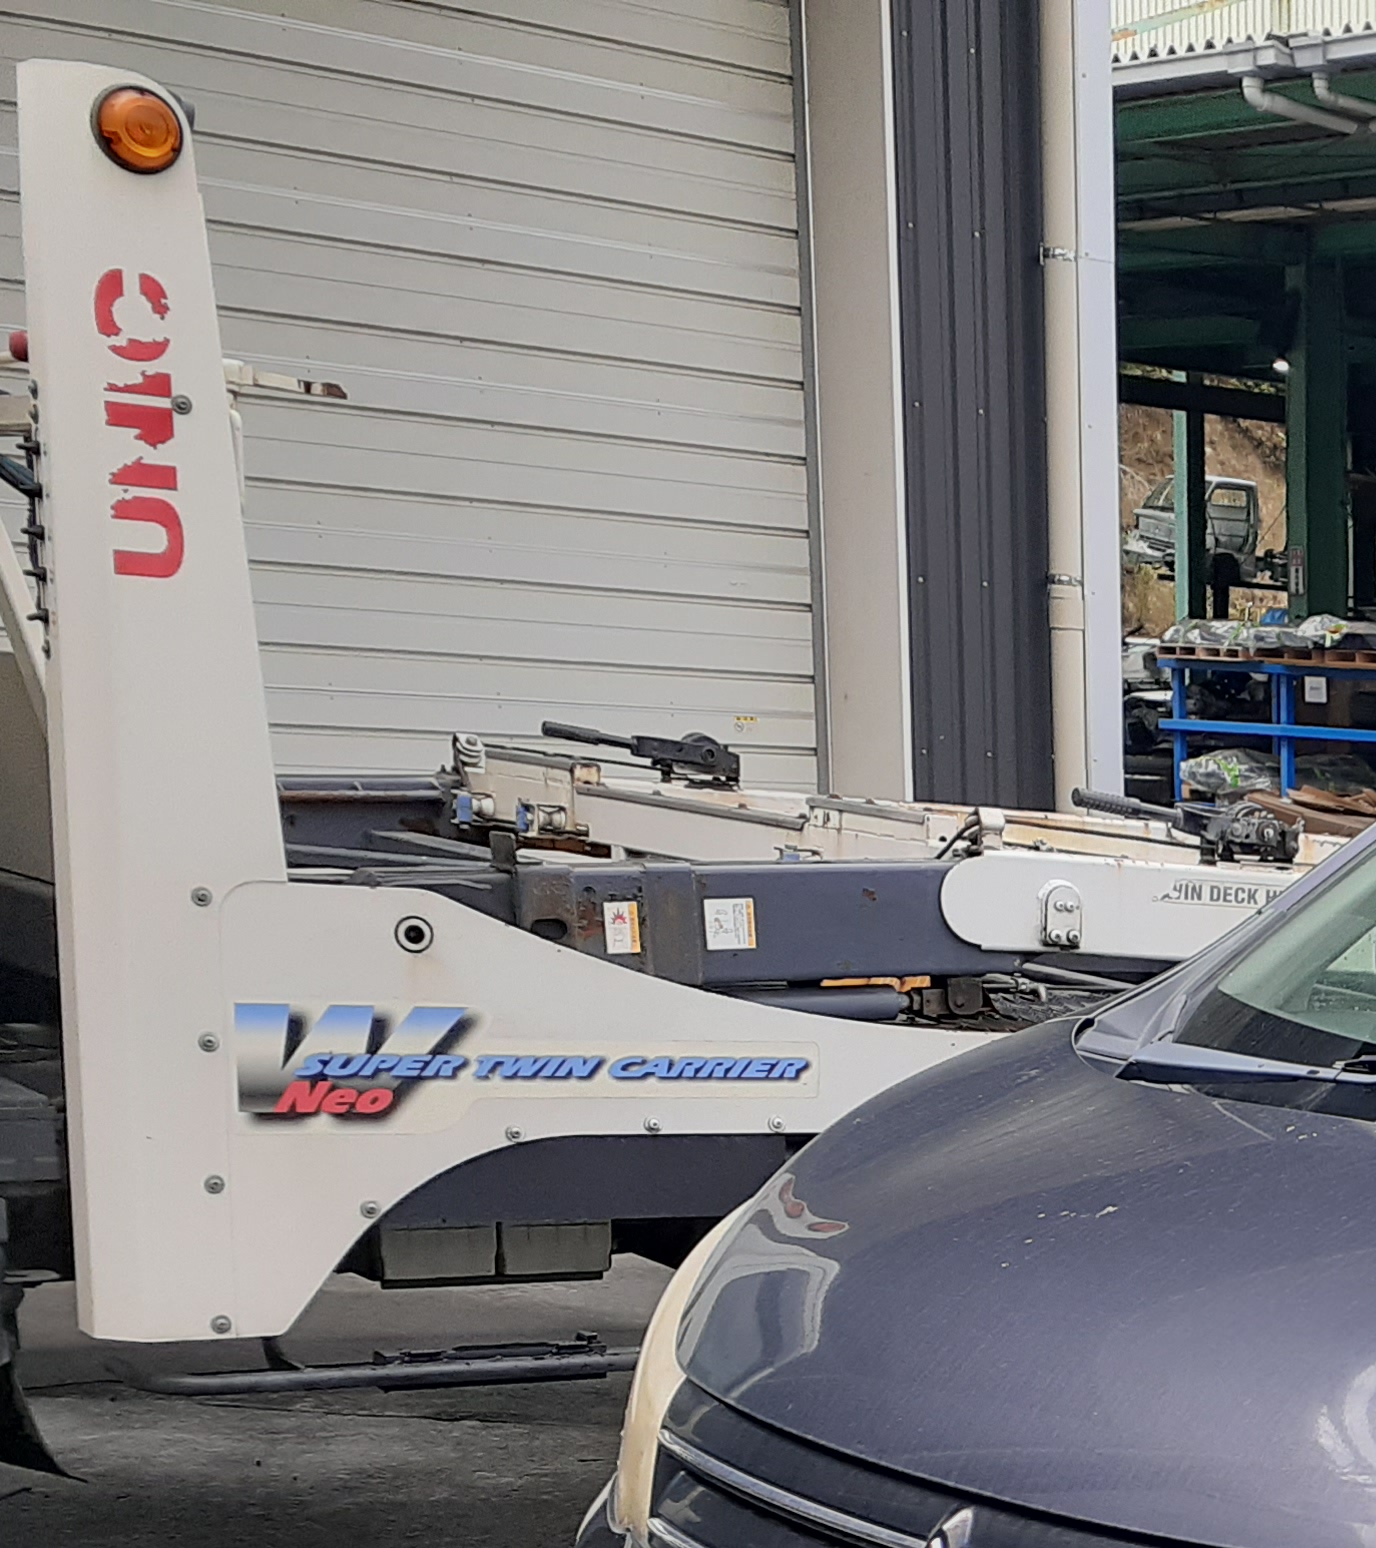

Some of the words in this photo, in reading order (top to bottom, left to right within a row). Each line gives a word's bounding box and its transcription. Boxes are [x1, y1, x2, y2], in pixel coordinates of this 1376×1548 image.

[1209, 885, 1259, 905] DECK
[1266, 889, 1285, 905] H
[295, 1052, 467, 1080] SUPER
[473, 1055, 605, 1080] TWIN
[608, 1056, 809, 1082] CARRIER
[273, 1080, 395, 1114] Neo
